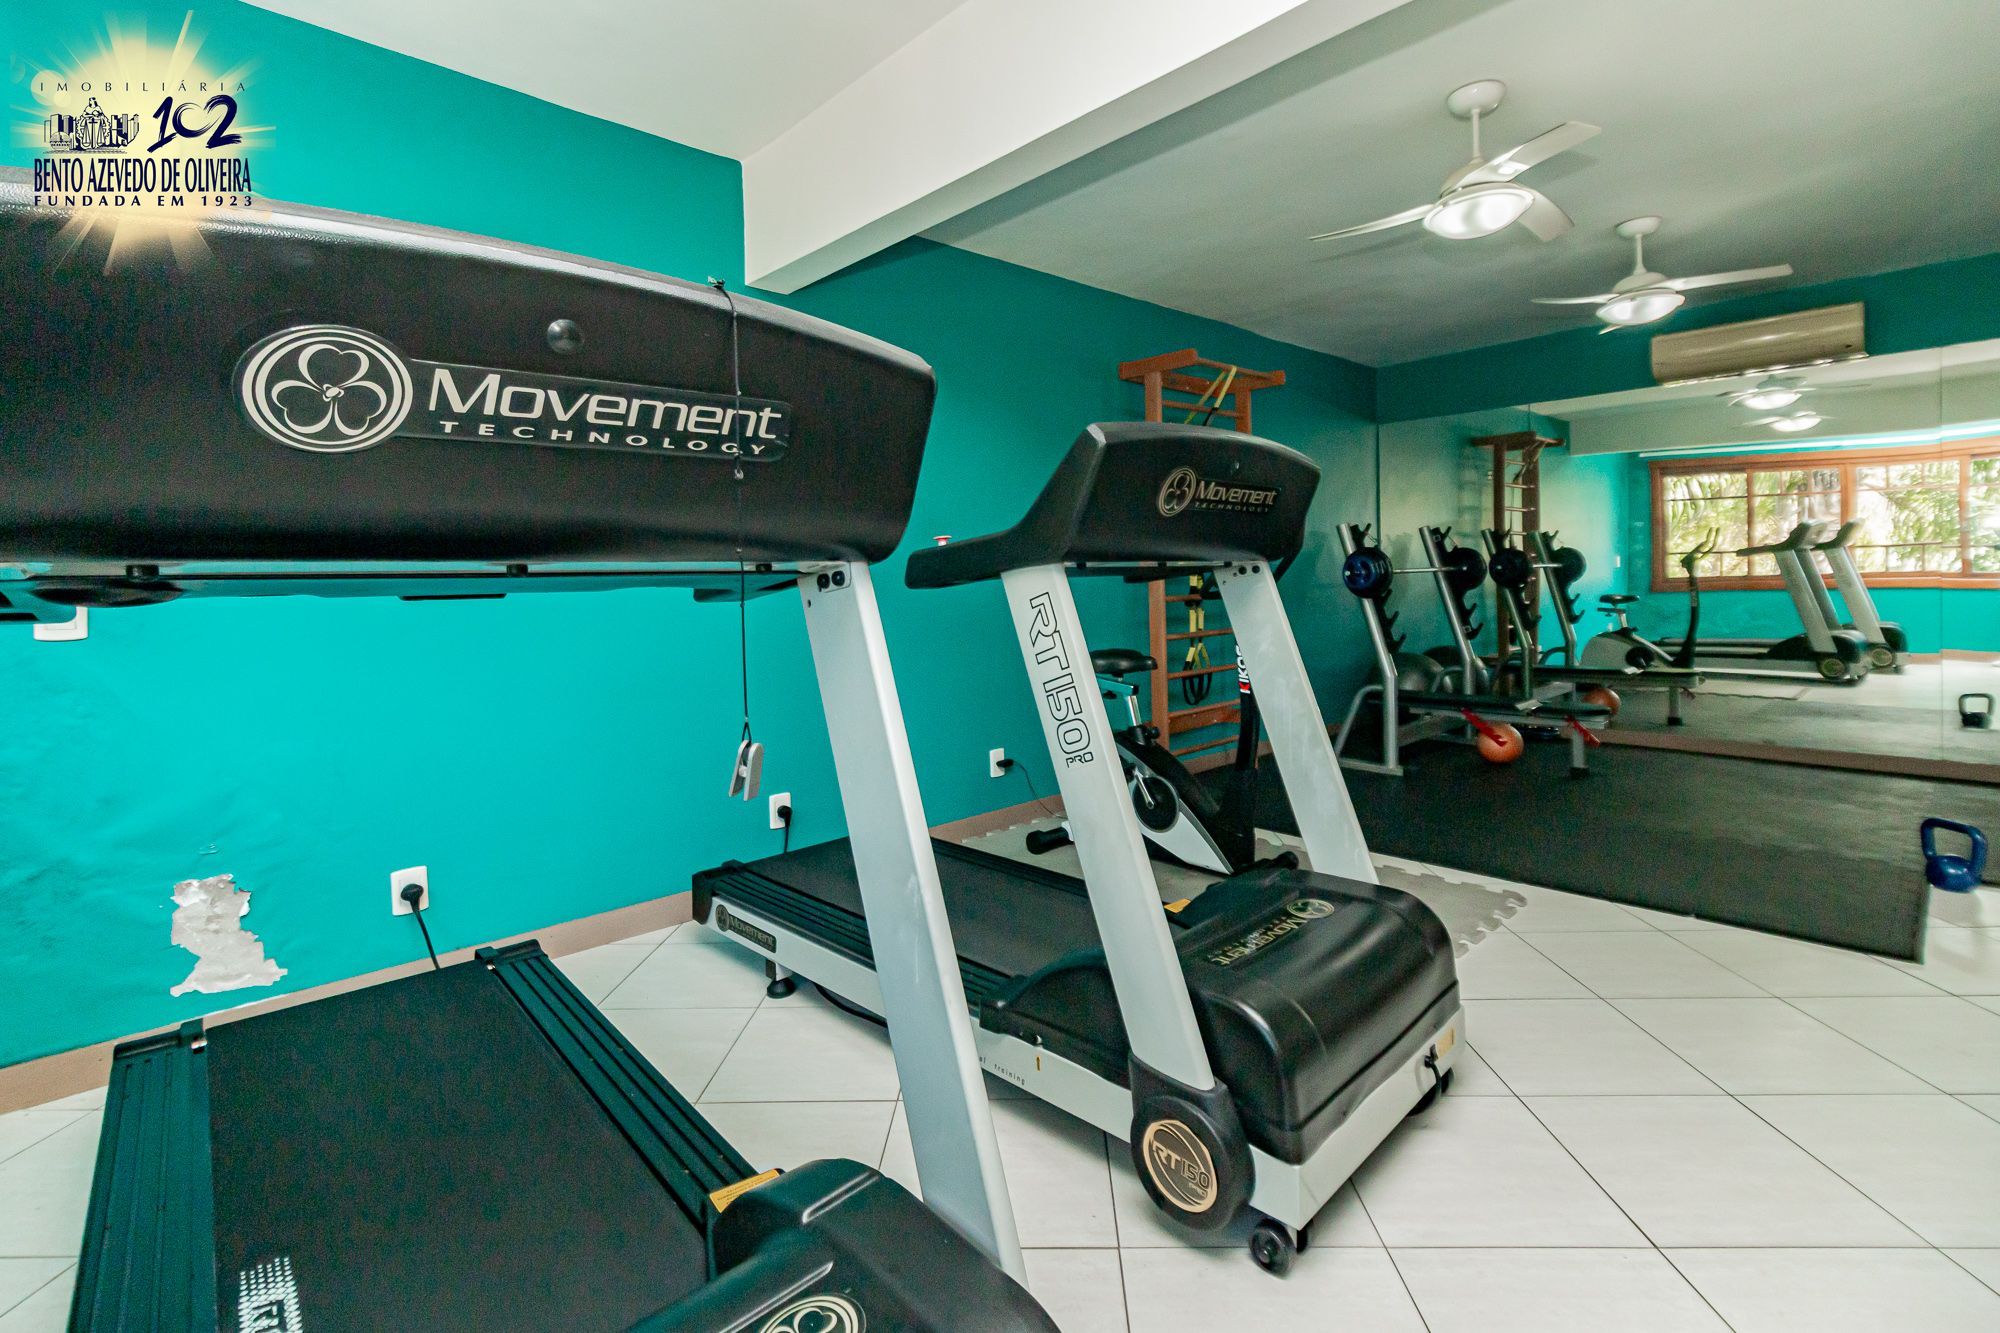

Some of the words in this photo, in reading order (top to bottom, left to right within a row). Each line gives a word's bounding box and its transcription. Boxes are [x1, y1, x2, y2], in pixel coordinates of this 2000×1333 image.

[428, 368, 783, 440] Movement
[439, 420, 767, 456] TECHNOLOGY
[1195, 480, 1277, 505] Movement
[1066, 751, 1094, 769] PRO
[994, 1063, 1025, 1086] training
[1152, 1140, 1211, 1190] RT150
